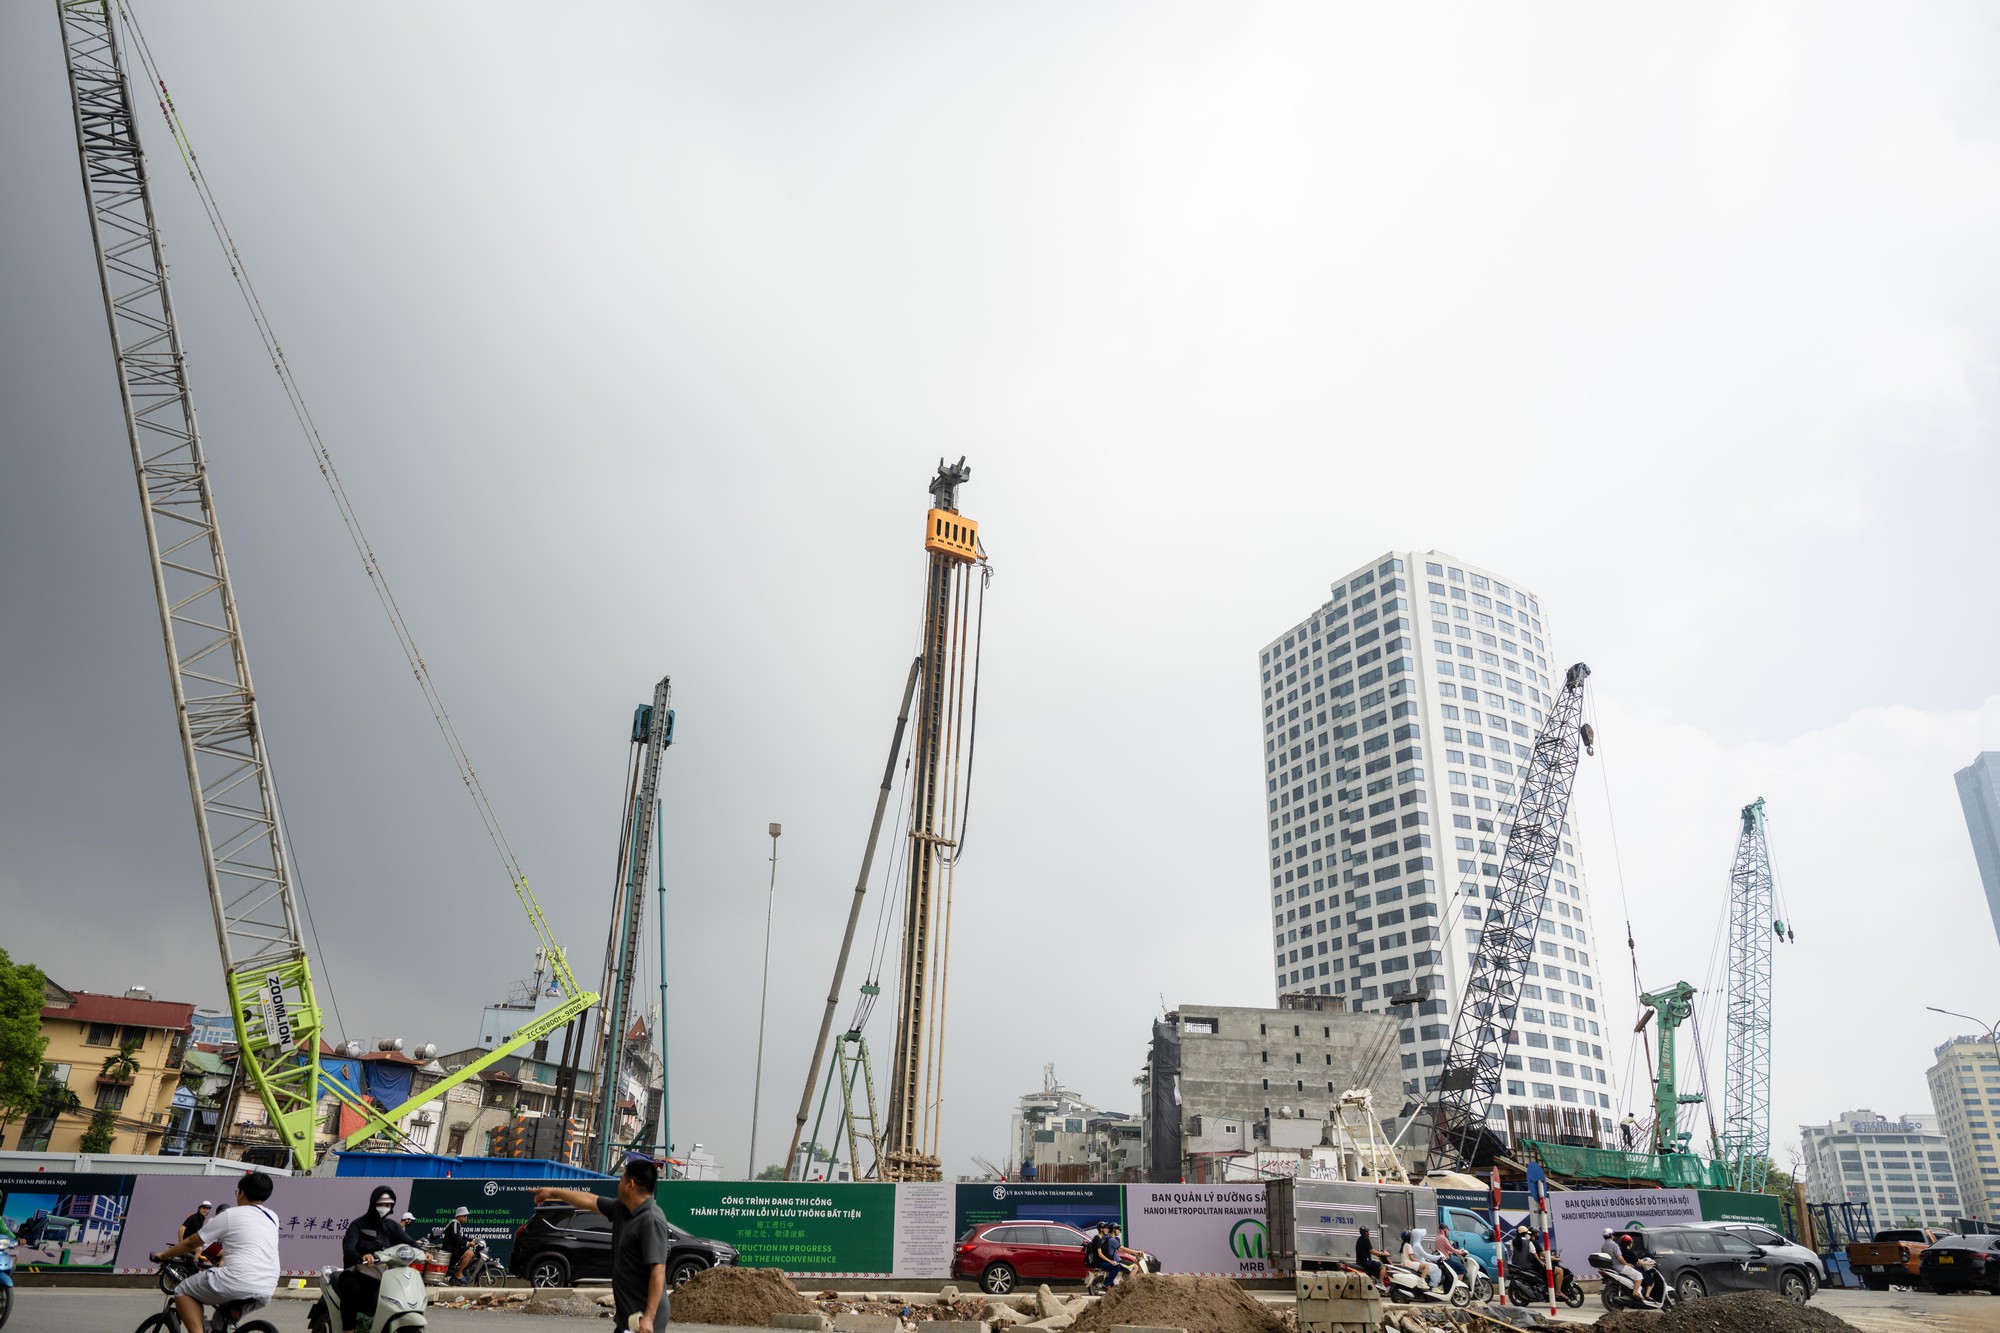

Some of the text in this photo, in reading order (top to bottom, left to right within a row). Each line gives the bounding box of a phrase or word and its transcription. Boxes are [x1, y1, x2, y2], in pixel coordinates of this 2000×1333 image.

[269, 976, 291, 1044] ZOOMLION
[722, 1196, 744, 1205] CÔNG
[745, 1196, 770, 1205] TRÌNH
[810, 1197, 832, 1206] CÔNG
[1152, 1194, 1172, 1202] BAN
[1174, 1191, 1202, 1203] QUẢN
[1204, 1191, 1214, 1202] LÝ
[1216, 1191, 1252, 1202] ĐƯỜNG
[1565, 1200, 1579, 1208] BAN
[1580, 1197, 1600, 1209] QUẢN
[1602, 1197, 1609, 1206] LÝ
[1610, 1196, 1634, 1206] ĐƯỜNG
[1658, 1198, 1669, 1207] THỊ
[1669, 1195, 1678, 1204] HÀ
[690, 1206, 718, 1216] THÀNH
[719, 1207, 740, 1218] THẬT
[771, 1208, 779, 1216] VÌ
[798, 1208, 826, 1218] THÔNG
[827, 1208, 842, 1218] BẤT
[843, 1209, 862, 1219] TIỆN
[1579, 1211, 1617, 1220] METROPOLITAN
[1240, 1262, 1264, 1271] MRB
